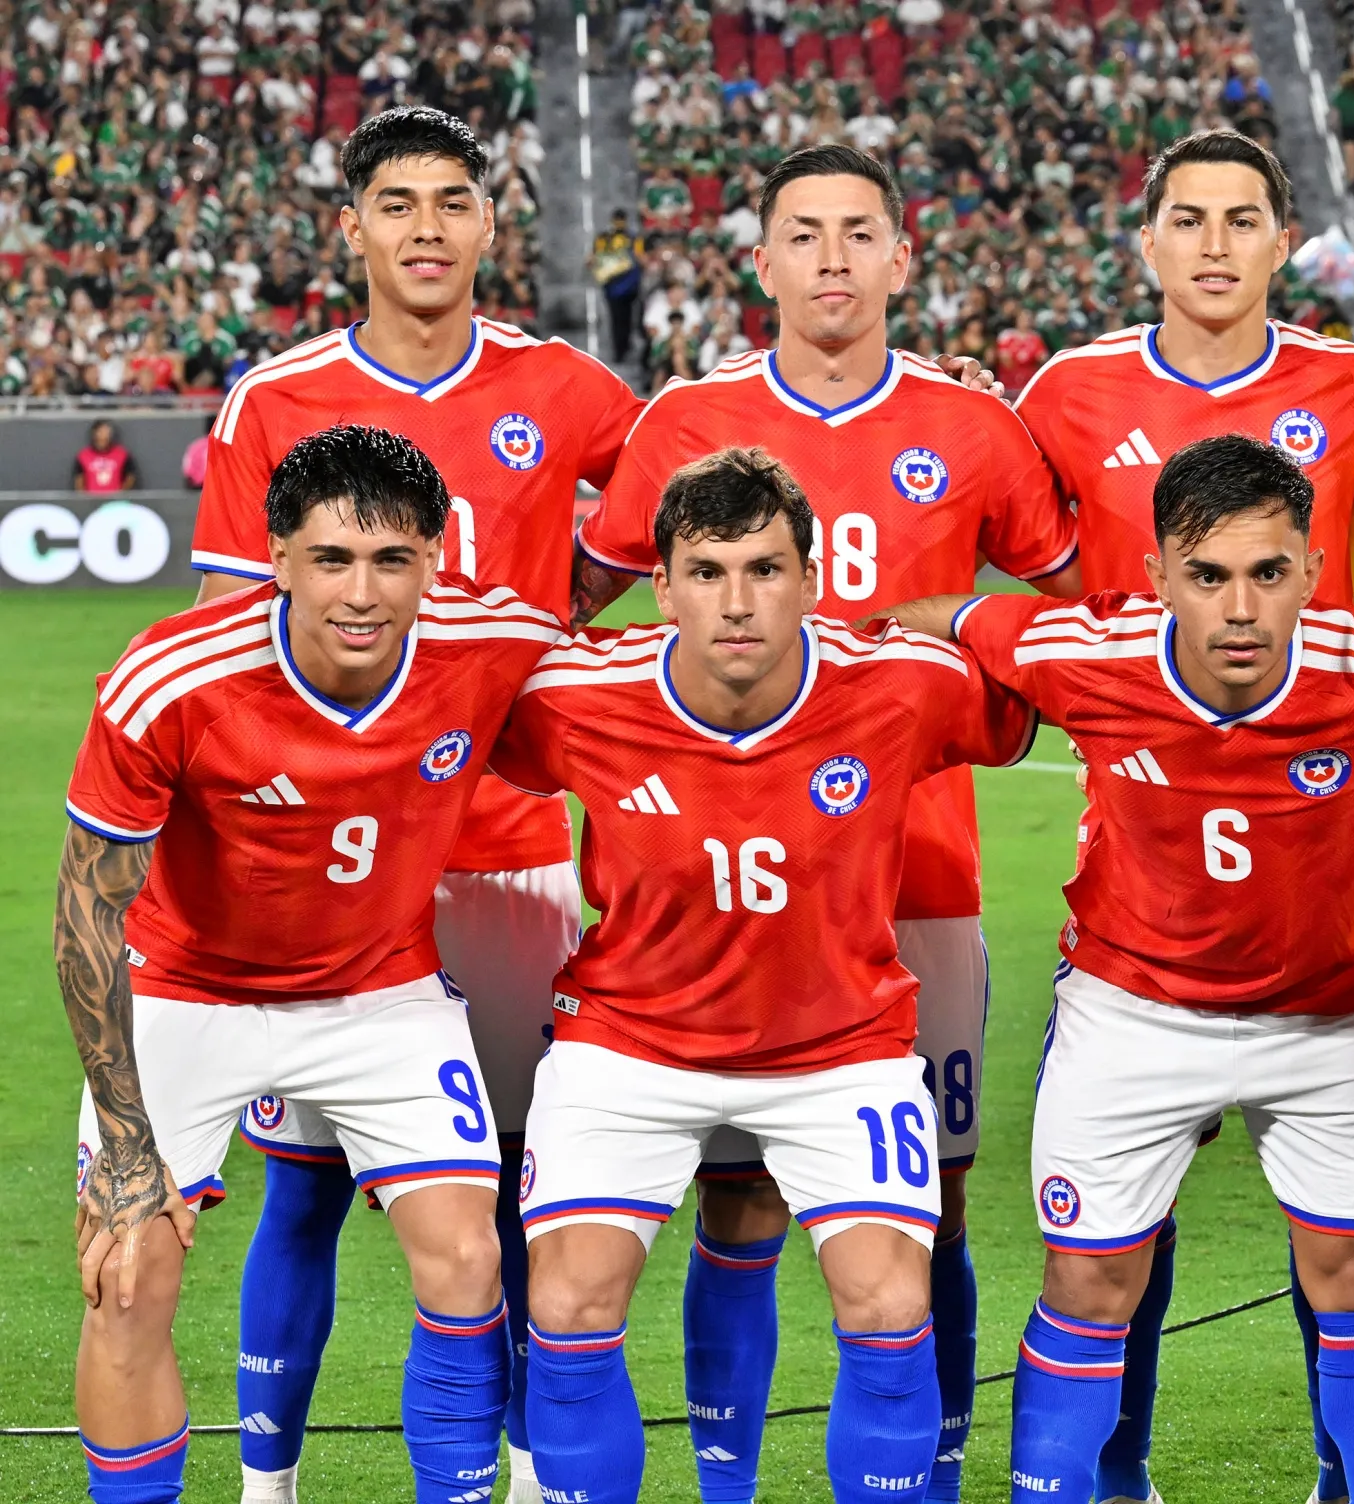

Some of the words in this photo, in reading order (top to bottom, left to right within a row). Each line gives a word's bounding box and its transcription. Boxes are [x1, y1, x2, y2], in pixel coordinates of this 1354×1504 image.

[491, 415, 513, 444] FEDERACION
[526, 418, 541, 442] FUTBOL
[1272, 411, 1297, 439] FEDERACION
[1310, 414, 1325, 438] FUTBOL
[520, 459, 536, 469] CHILE
[893, 449, 919, 475] FEDERACION
[932, 455, 947, 478] FUTBOL
[1299, 455, 1317, 464] CHILE
[920, 494, 936, 503] CHILE
[0, 500, 170, 583] CO
[1290, 751, 1318, 773] FEDERACION
[1333, 750, 1350, 767] FUTBOL
[443, 768, 460, 779] CHILE
[811, 758, 838, 790] FEDERACION
[853, 761, 868, 781] FUTBOL
[1320, 785, 1338, 795] CHILE
[840, 801, 857, 814] CHILE
[326, 815, 379, 883] 9
[1202, 808, 1252, 882] 6
[703, 836, 788, 914] 16
[438, 1060, 487, 1142] 9
[857, 1101, 930, 1188] 16
[240, 1351, 285, 1374] CHILE
[688, 1401, 735, 1420] CHILE
[940, 1412, 970, 1430] HILE
[864, 1472, 926, 1491] CHILE
[1013, 1470, 1060, 1492] CHILE
[539, 1483, 589, 1504] CHILE
